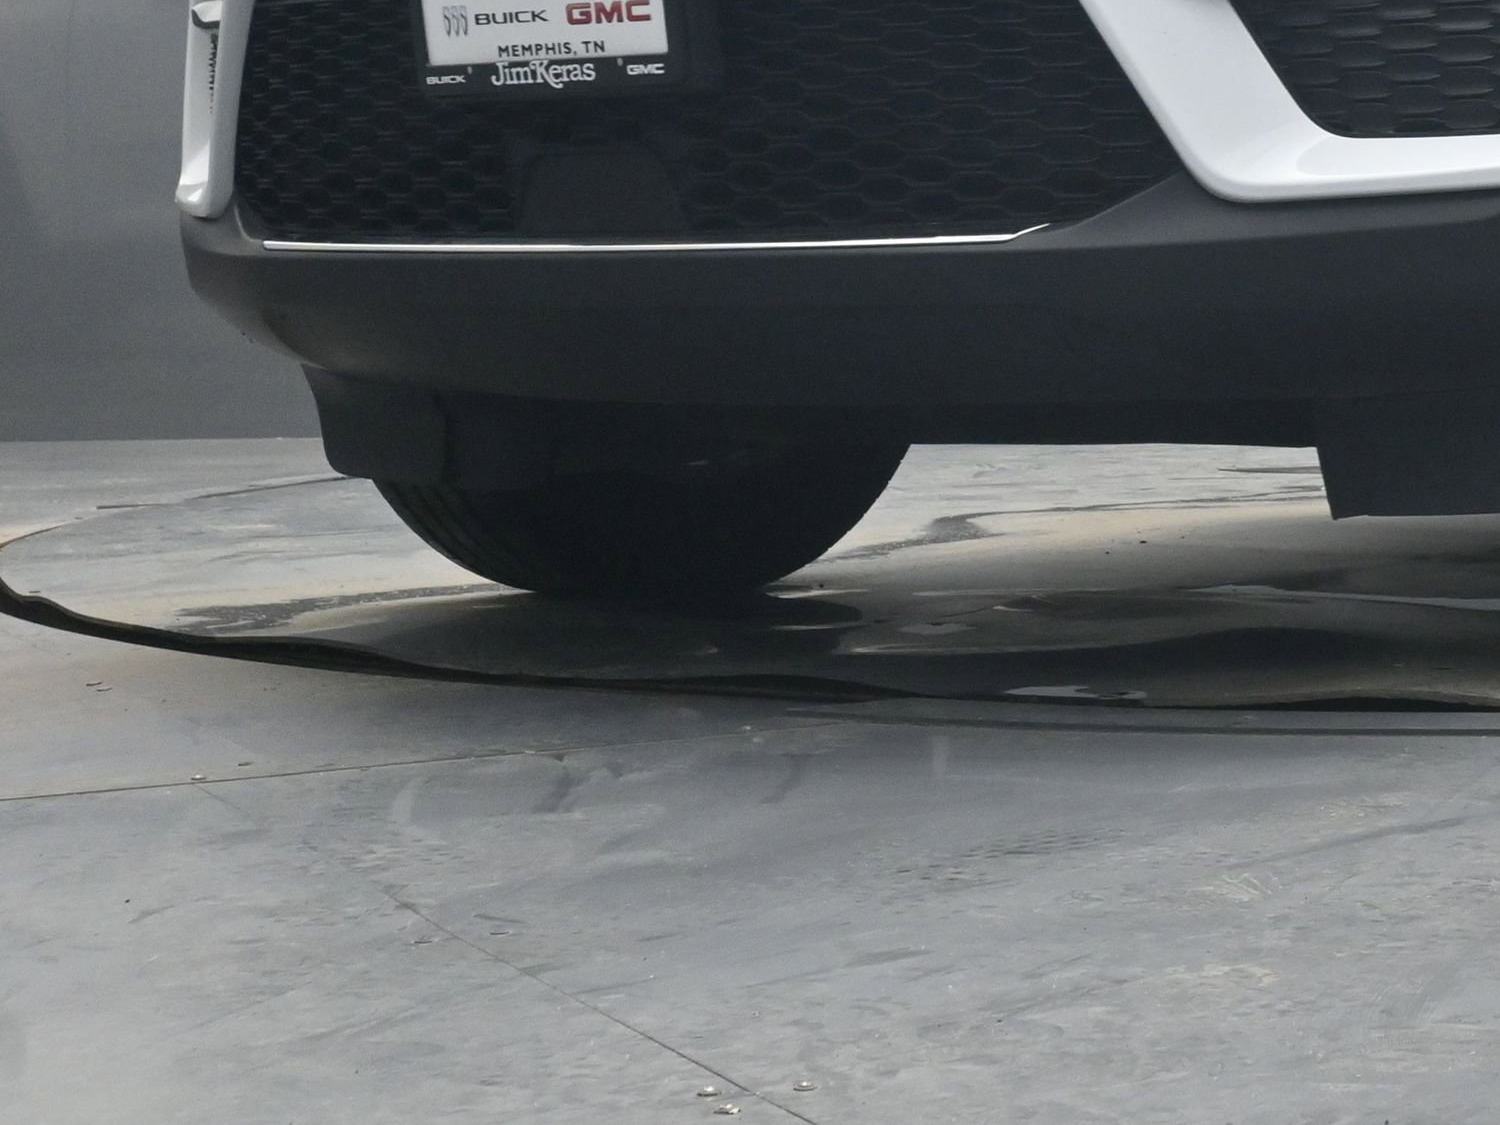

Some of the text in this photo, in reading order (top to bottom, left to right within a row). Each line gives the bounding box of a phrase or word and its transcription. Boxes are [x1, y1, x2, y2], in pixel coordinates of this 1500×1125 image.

[474, 9, 549, 25] BUICK
[498, 40, 606, 58] MEMPHIS, TN
[426, 59, 665, 88] BUICK JimKeras GMC
